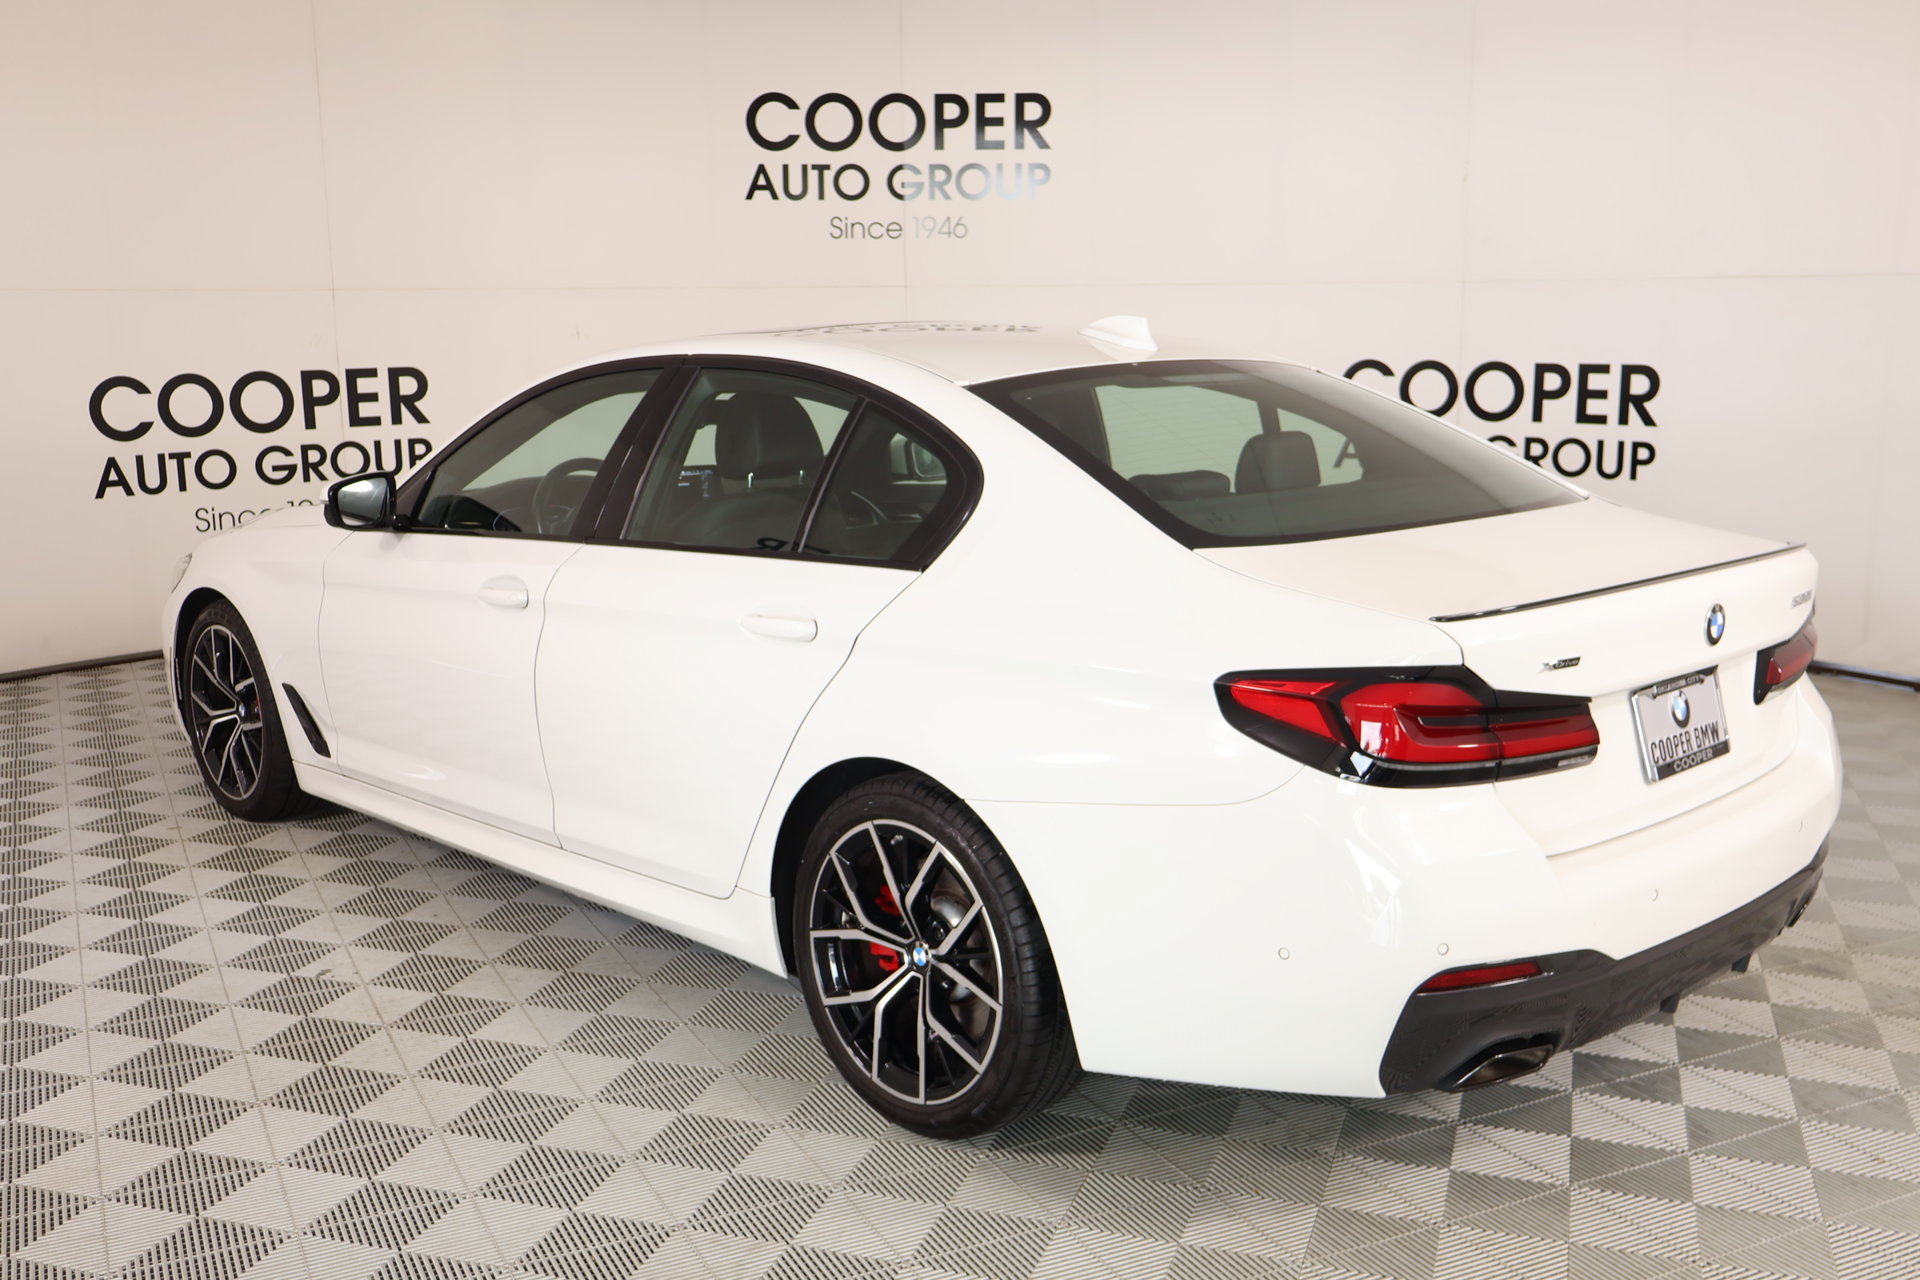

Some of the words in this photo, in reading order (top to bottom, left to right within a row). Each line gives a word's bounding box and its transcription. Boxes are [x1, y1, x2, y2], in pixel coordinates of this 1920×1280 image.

[745, 92, 1052, 152] COOPER
[745, 163, 870, 201] AUTO
[887, 163, 1052, 201] GROUP
[829, 216, 903, 240] Since
[911, 216, 969, 240] 1946
[89, 367, 431, 442] COOPER
[95, 448, 237, 499] AUTO
[1650, 730, 1693, 764] COOPER
[1694, 721, 1720, 748] BMW
[1674, 749, 1713, 772] COOPER
